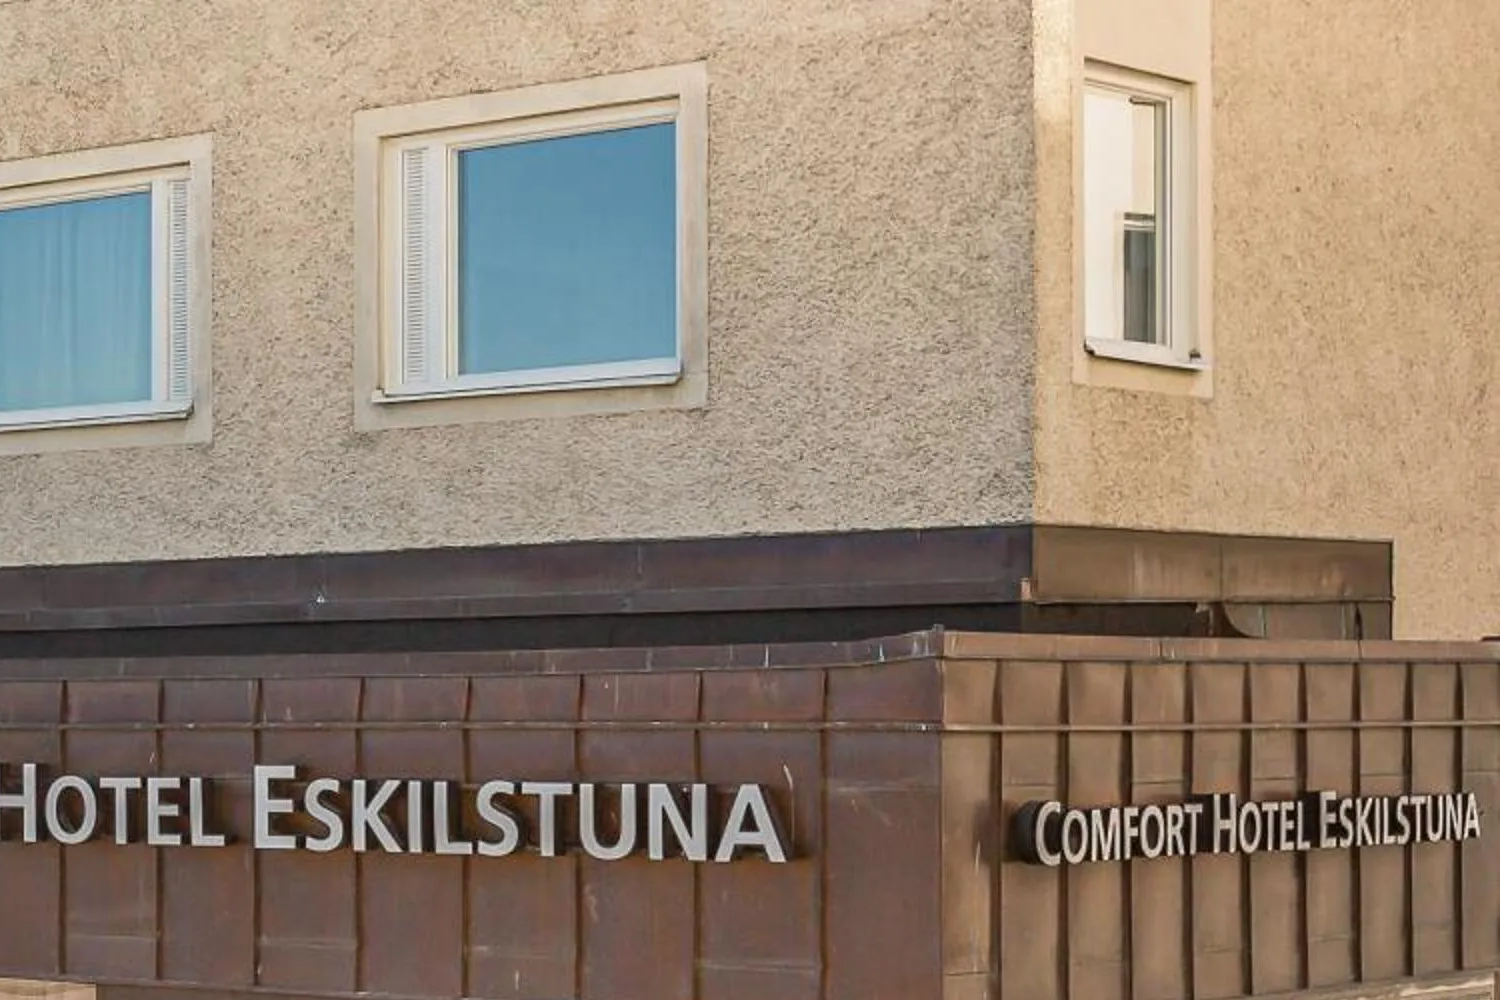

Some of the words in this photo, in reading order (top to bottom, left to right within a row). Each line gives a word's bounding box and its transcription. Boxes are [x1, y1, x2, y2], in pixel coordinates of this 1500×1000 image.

[253, 764, 787, 863] ESKILSTUNA
[1035, 801, 1203, 866] COMFORT
[1212, 792, 1311, 854] HOTEL
[1319, 790, 1481, 849] ESKILSTUNA
